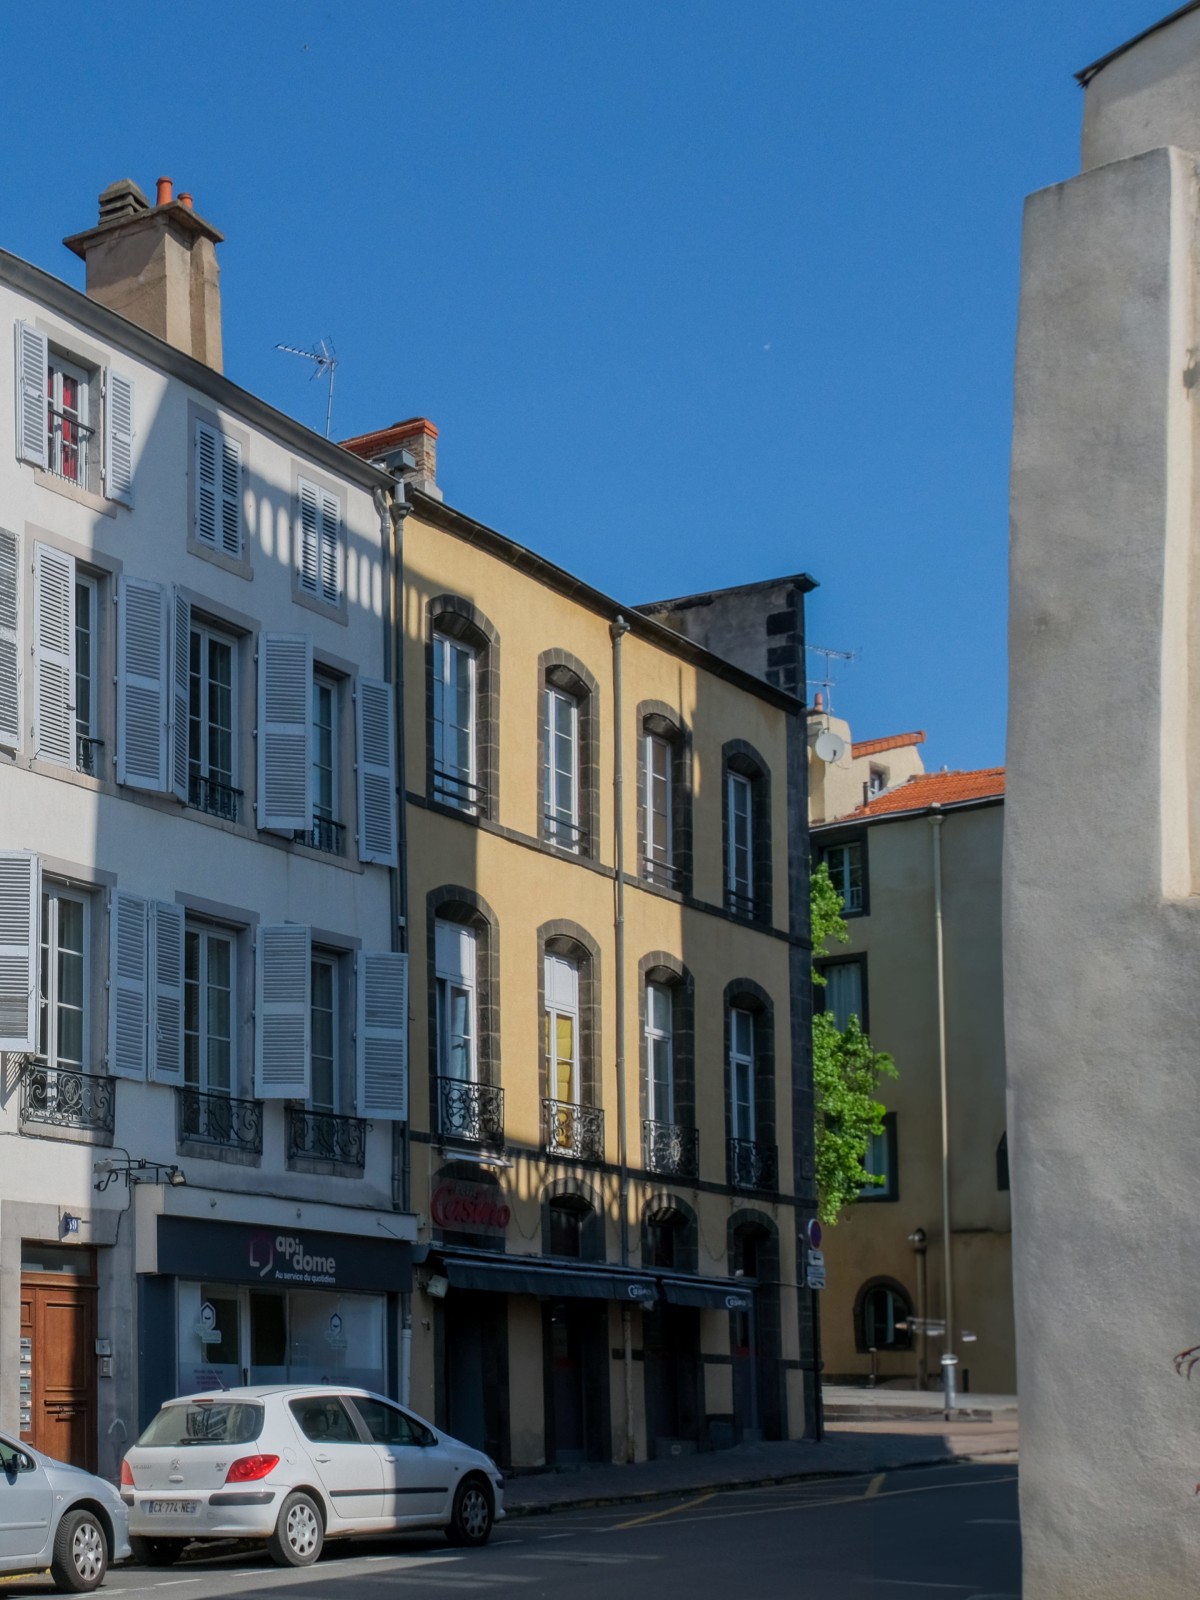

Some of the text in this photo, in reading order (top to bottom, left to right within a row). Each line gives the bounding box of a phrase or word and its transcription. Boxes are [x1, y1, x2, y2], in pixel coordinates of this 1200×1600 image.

[431, 1184, 511, 1229] Casino
[293, 1245, 336, 1274] dome
[275, 1270, 336, 1284] Au service du quotidien
